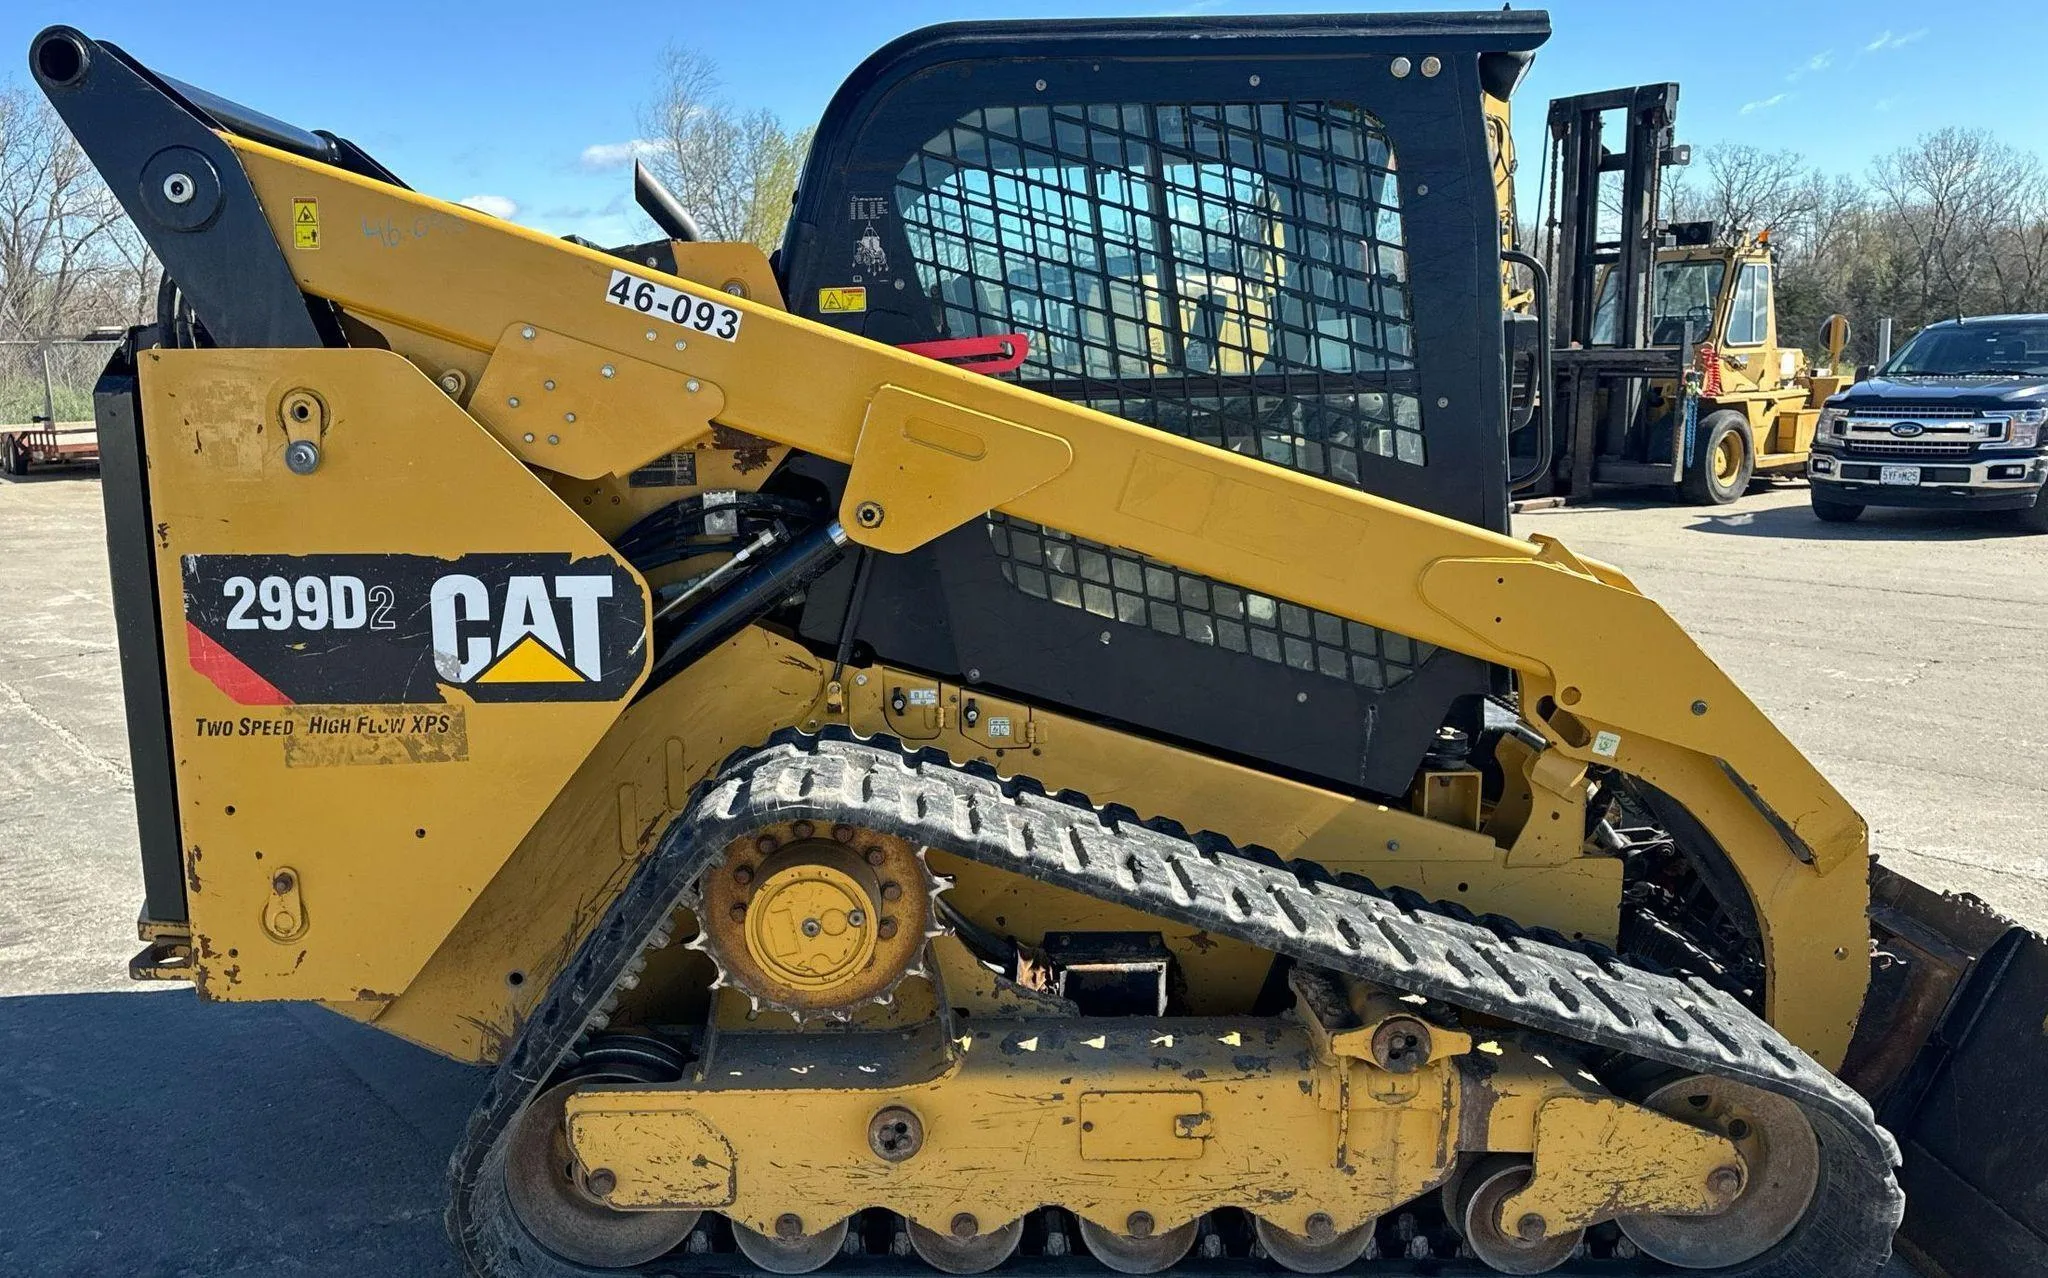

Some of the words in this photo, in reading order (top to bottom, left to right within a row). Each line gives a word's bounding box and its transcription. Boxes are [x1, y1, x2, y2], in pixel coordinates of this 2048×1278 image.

[609, 276, 738, 339] 46-093
[430, 574, 613, 683] CAT
[309, 715, 351, 735] HIGH
[410, 714, 451, 735] XPS
